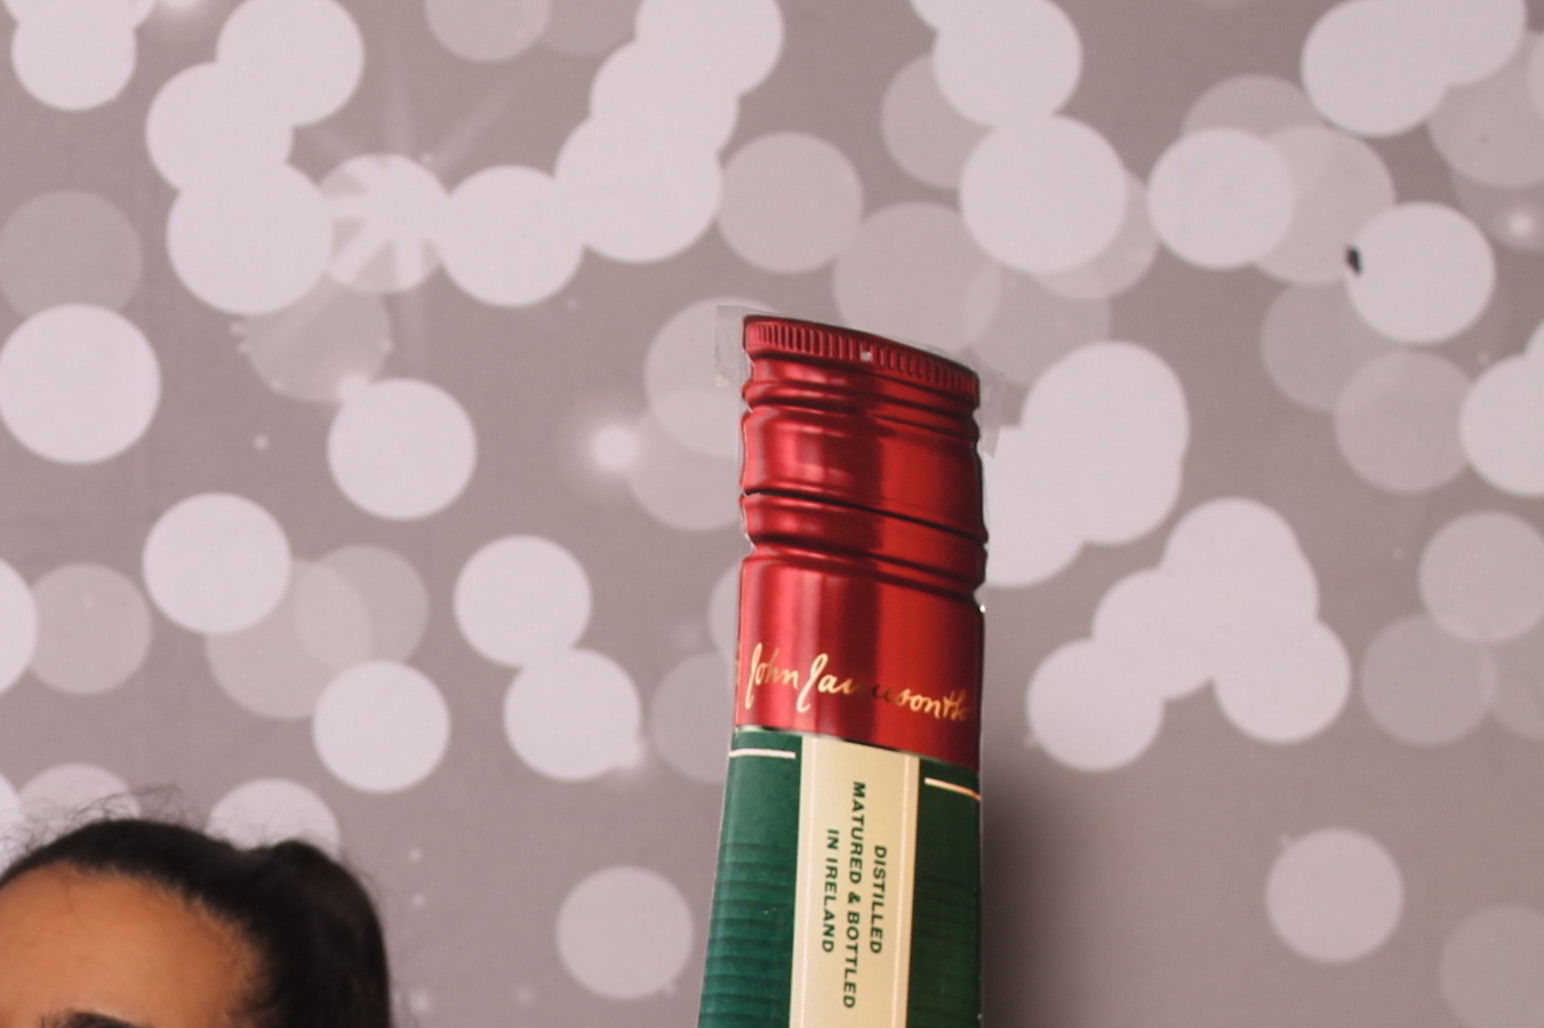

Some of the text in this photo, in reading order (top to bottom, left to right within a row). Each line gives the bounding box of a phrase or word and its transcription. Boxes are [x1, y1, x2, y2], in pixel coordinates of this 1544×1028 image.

[822, 828, 840, 953] IN IRELAND
[842, 780, 867, 1010] MATURED & BOTTLED
[869, 844, 888, 954] DISTILLED
